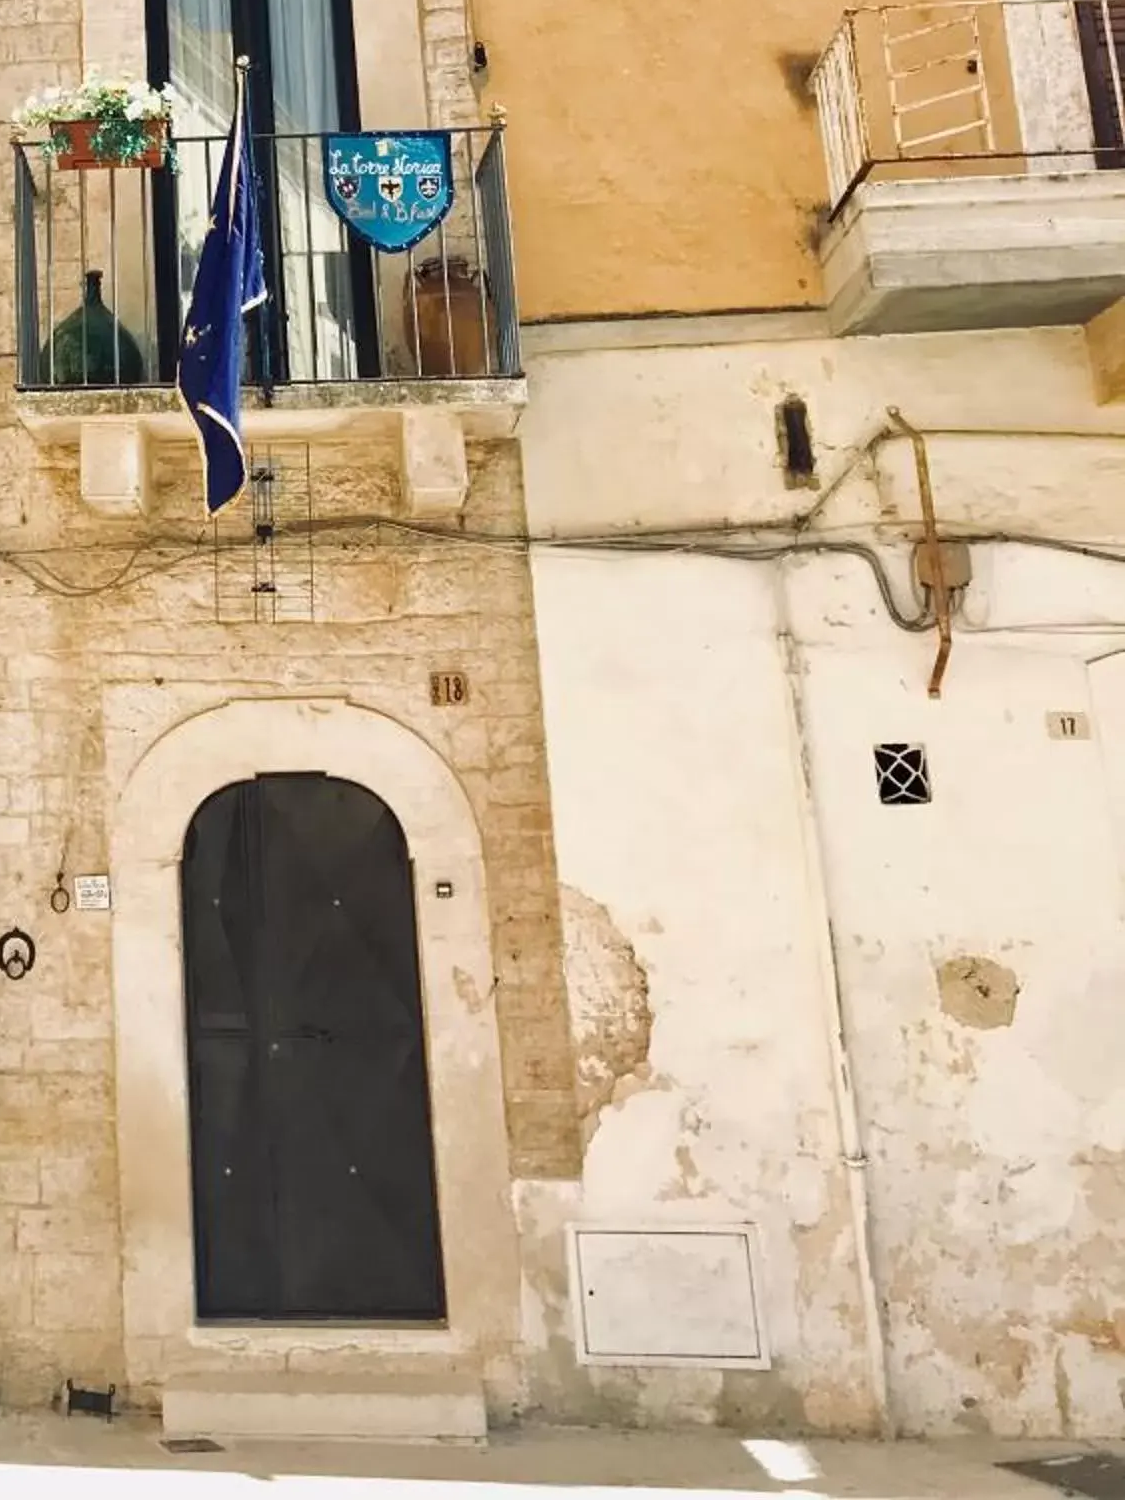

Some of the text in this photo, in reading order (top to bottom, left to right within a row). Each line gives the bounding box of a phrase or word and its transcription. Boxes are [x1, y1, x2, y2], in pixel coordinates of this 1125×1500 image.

[329, 149, 352, 175] La
[444, 675, 463, 702] 18
[1060, 717, 1076, 736] 17
